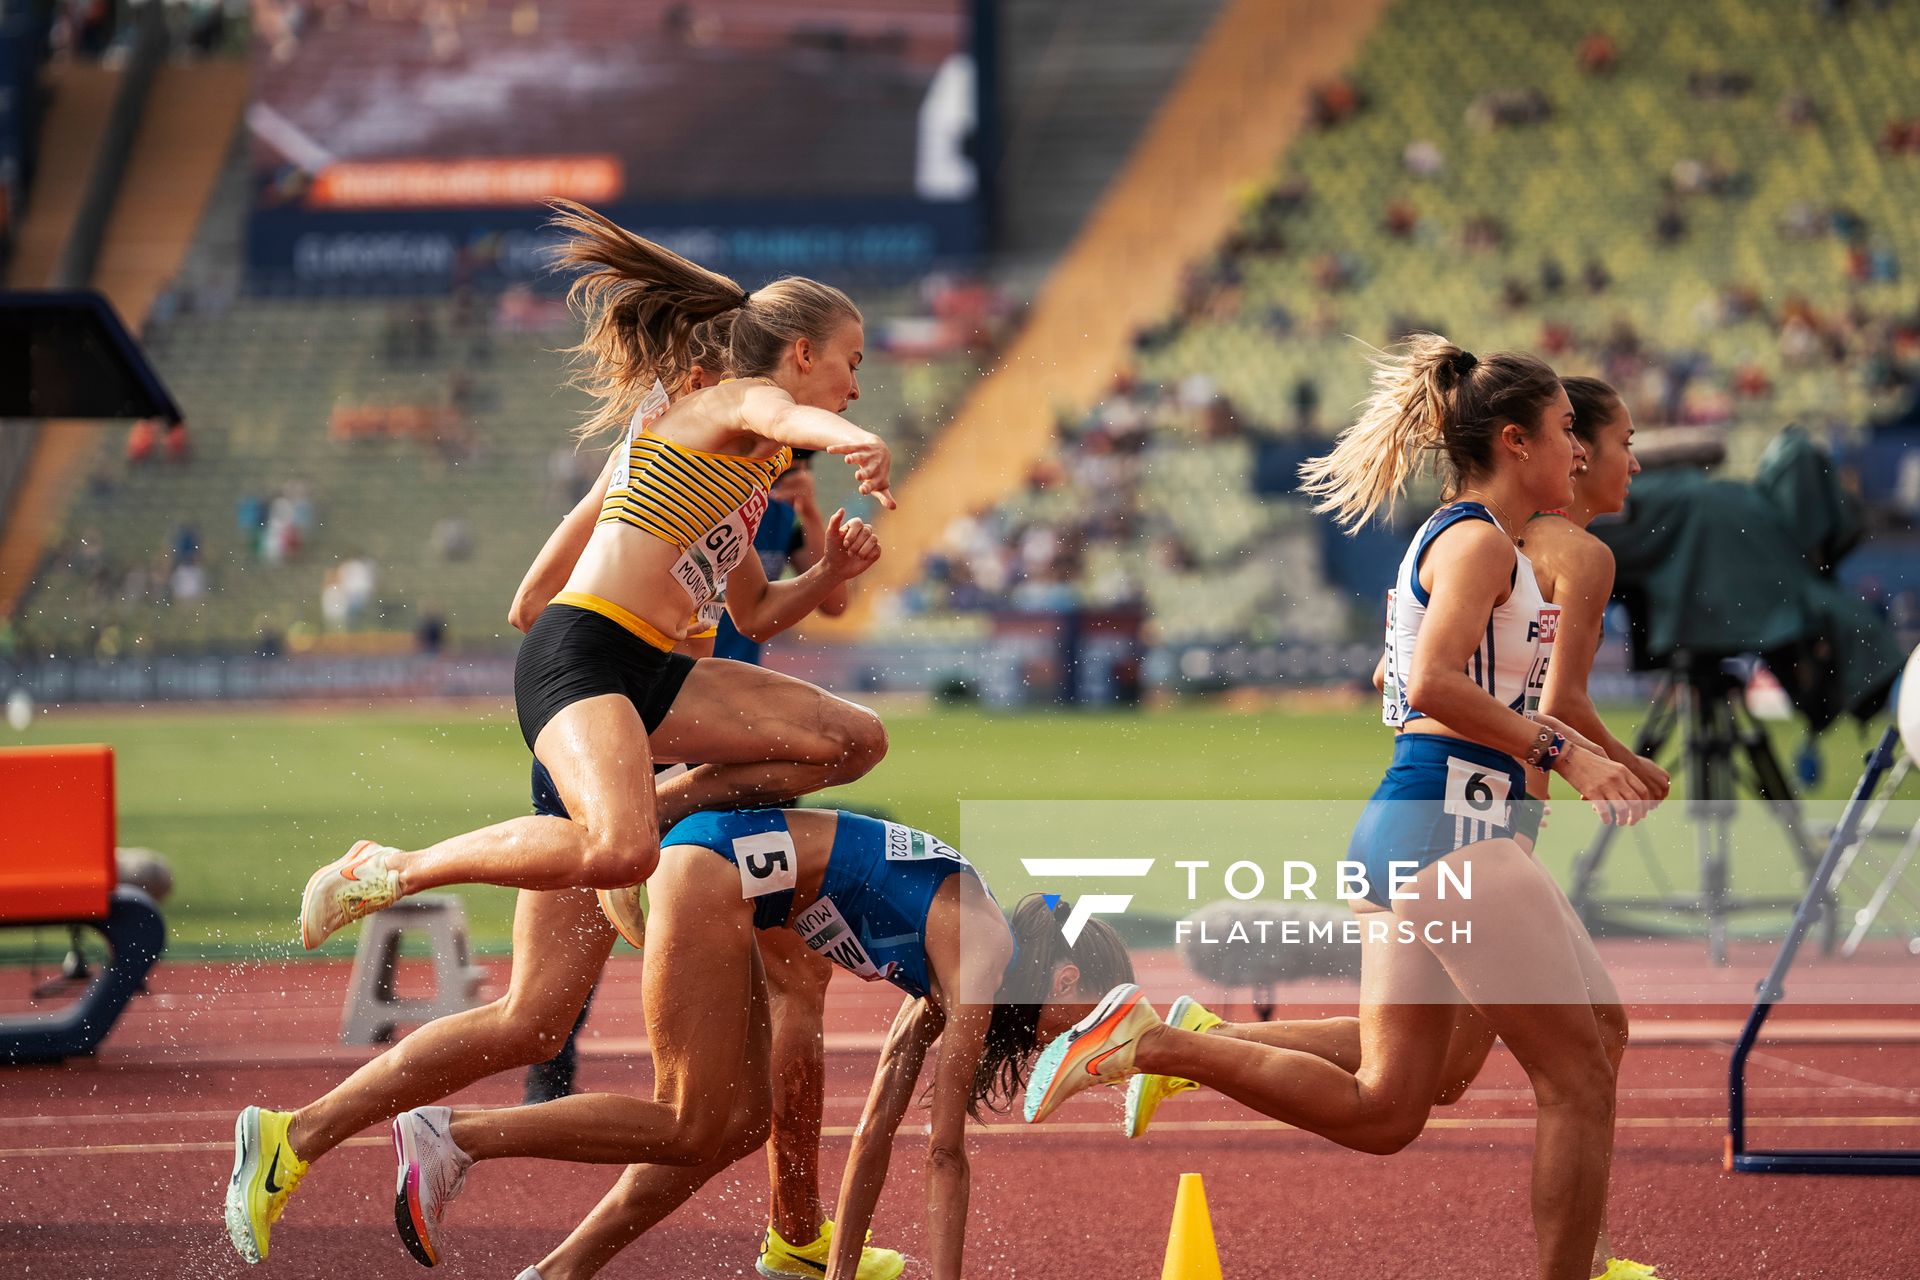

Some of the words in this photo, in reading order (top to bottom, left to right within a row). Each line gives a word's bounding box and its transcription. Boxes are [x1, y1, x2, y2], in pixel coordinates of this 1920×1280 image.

[1465, 772, 1493, 811] 6
[891, 828, 908, 858] 2022
[745, 850, 789, 879] 5
